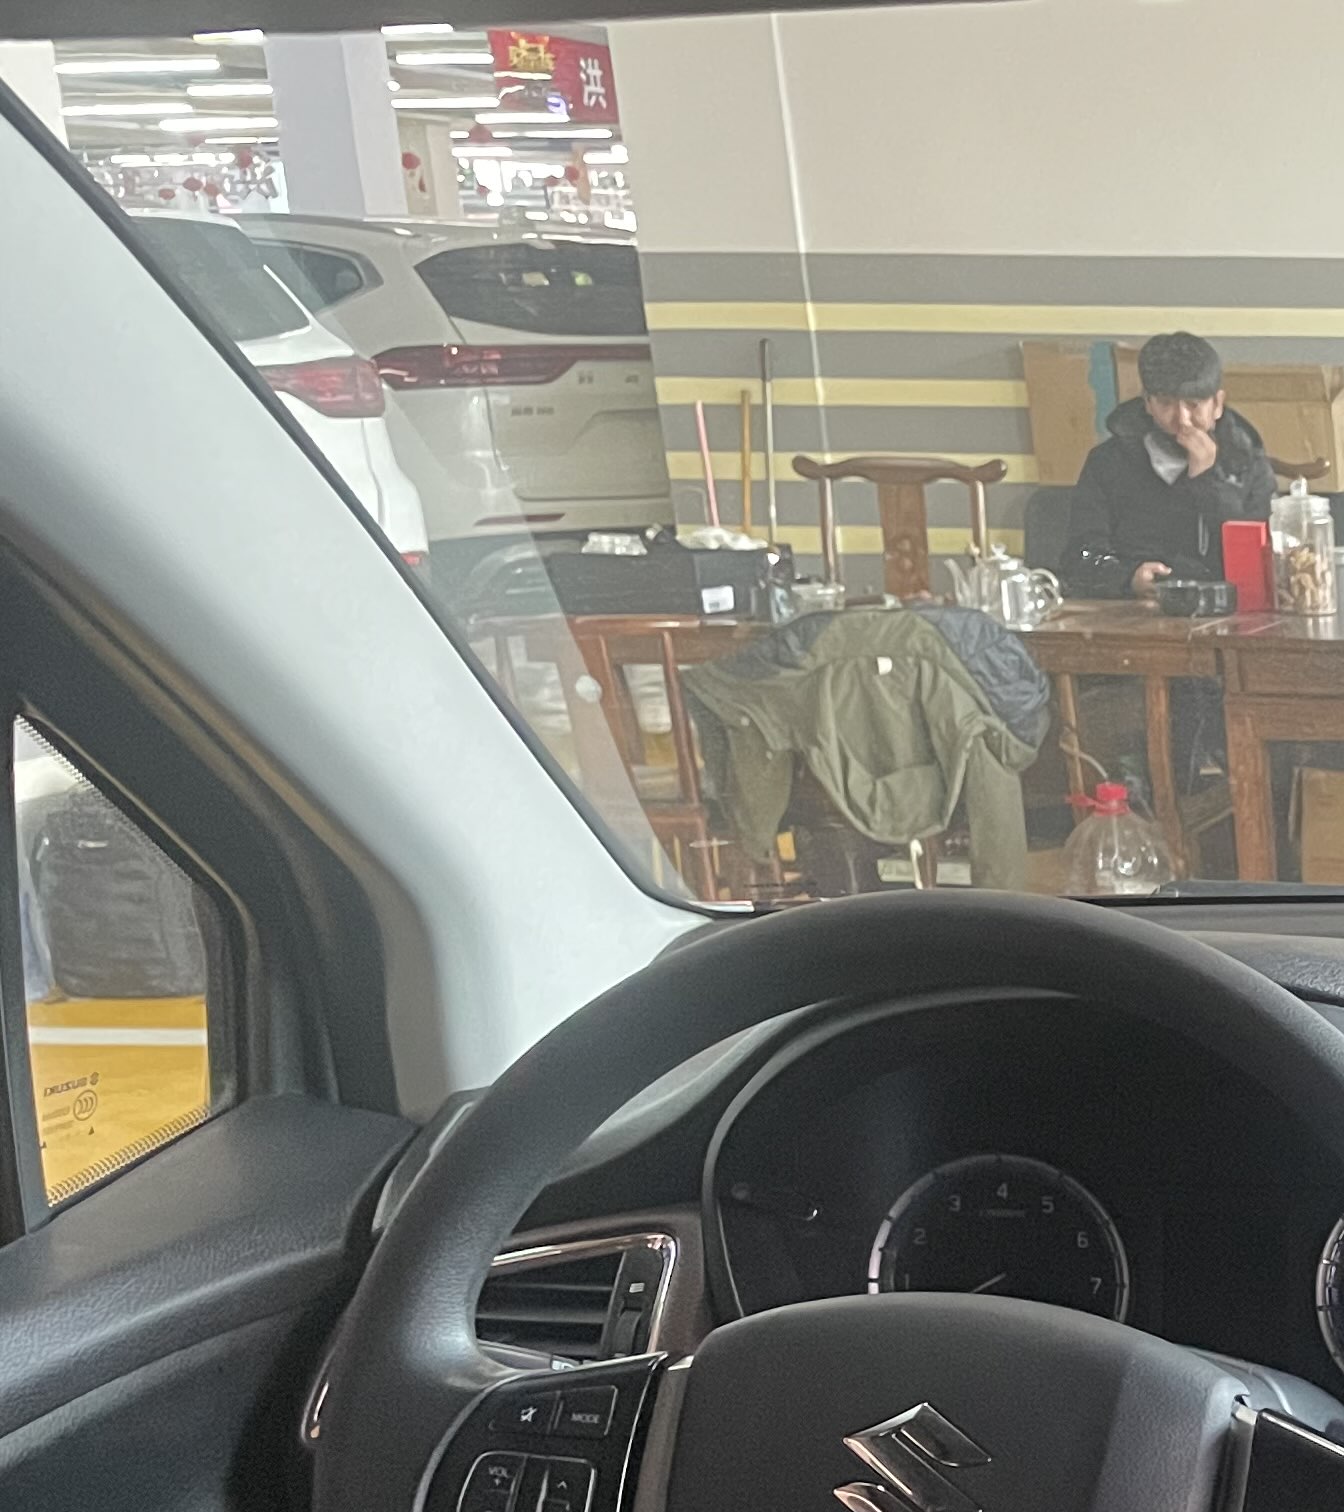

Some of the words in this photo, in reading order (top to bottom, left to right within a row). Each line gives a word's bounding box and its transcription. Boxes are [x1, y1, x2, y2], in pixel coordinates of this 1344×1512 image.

[996, 1183, 1008, 1200] 4
[948, 1195, 961, 1212] 3
[1042, 1196, 1055, 1213] 5
[913, 1228, 926, 1245] 2
[1077, 1231, 1089, 1249] 6
[1090, 1277, 1102, 1295] 7
[488, 1466, 509, 1479] VOL
